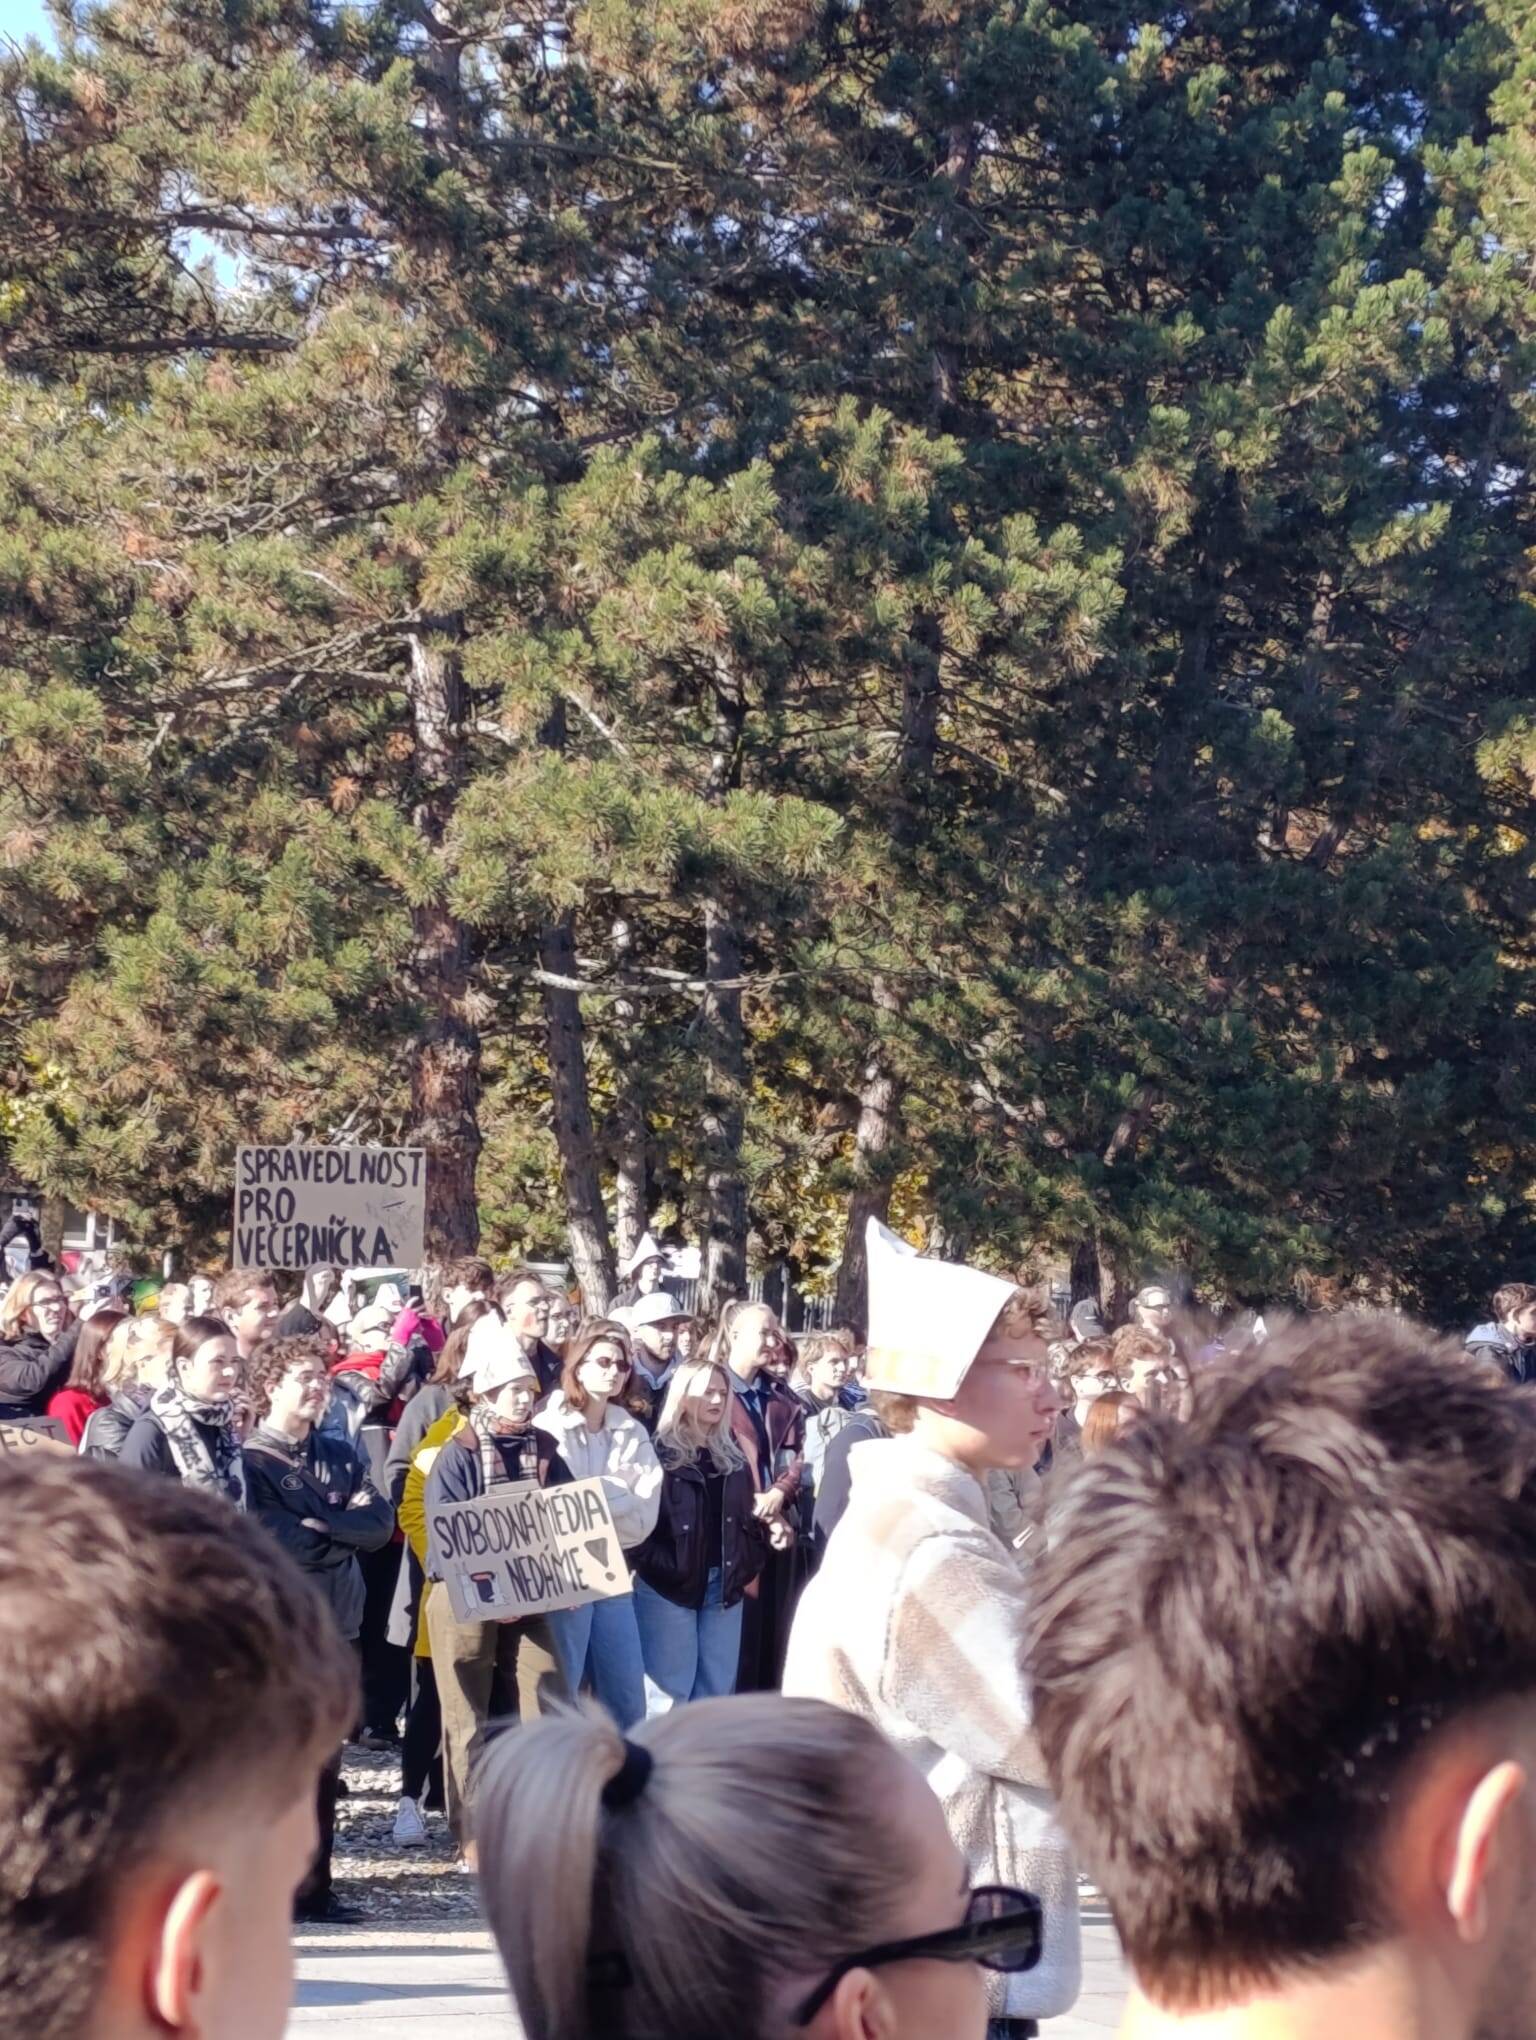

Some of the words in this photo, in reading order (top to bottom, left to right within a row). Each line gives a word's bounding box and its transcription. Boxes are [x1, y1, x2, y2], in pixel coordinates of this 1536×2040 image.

[241, 1147, 423, 1188] SPRAVEDLNOST
[239, 1187, 296, 1224] PRO
[237, 1214, 395, 1268] VEČERNÍČKA
[433, 1493, 536, 1559] SVOBODNÁ
[538, 1488, 609, 1539] MÉDIA
